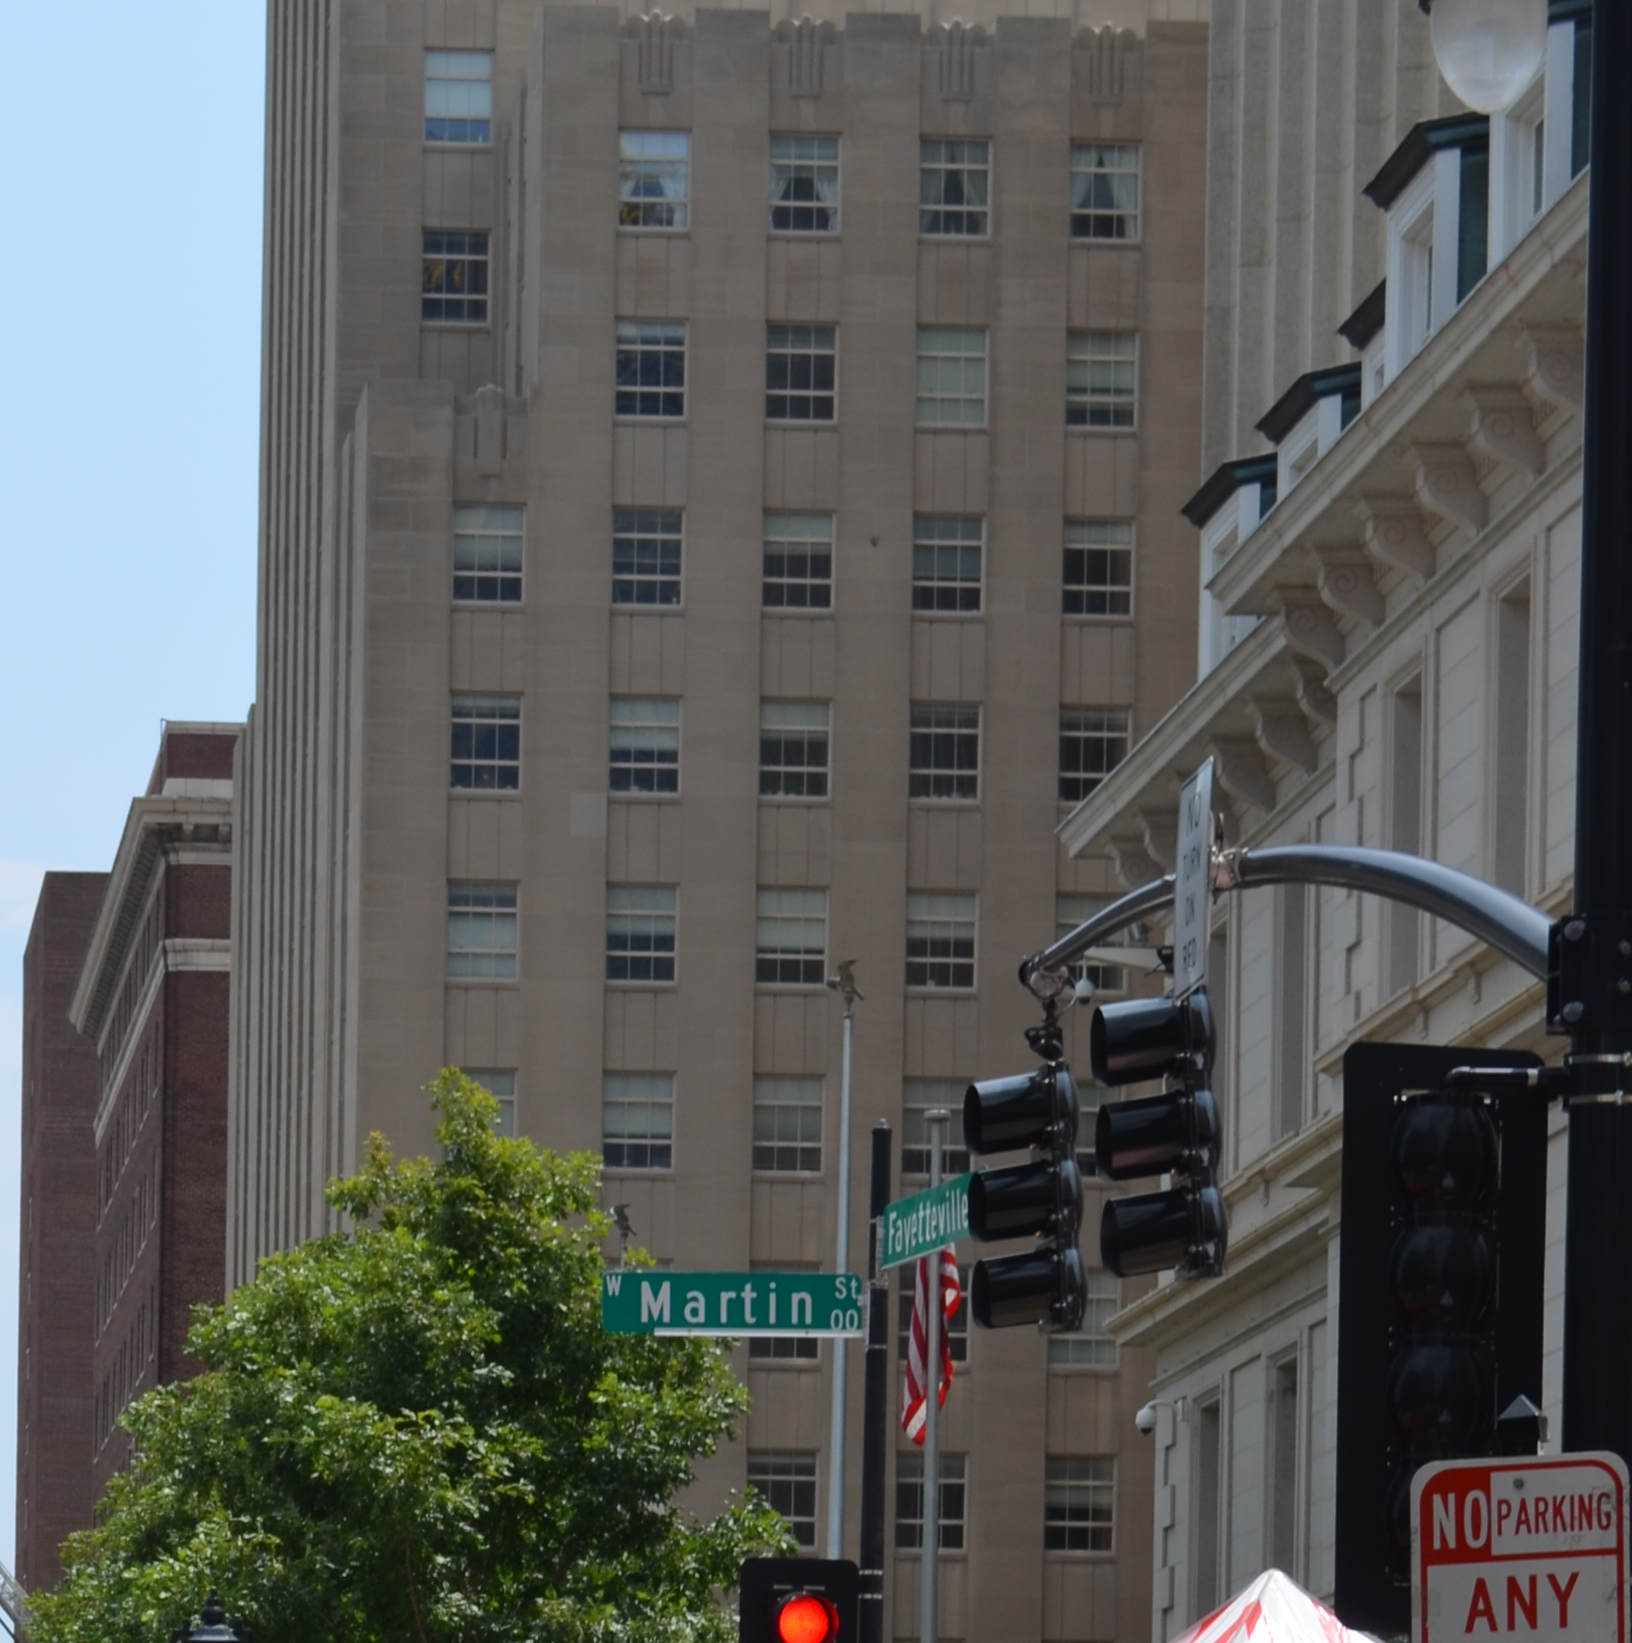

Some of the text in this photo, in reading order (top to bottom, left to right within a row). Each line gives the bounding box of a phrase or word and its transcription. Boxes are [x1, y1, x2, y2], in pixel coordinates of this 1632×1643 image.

[888, 1188, 969, 1256] Fayetteville
[606, 1275, 858, 1325] W Martin St
[830, 1309, 858, 1331] 00
[1432, 1488, 1612, 1550] NO PARKING
[1464, 1571, 1580, 1634] ANY
